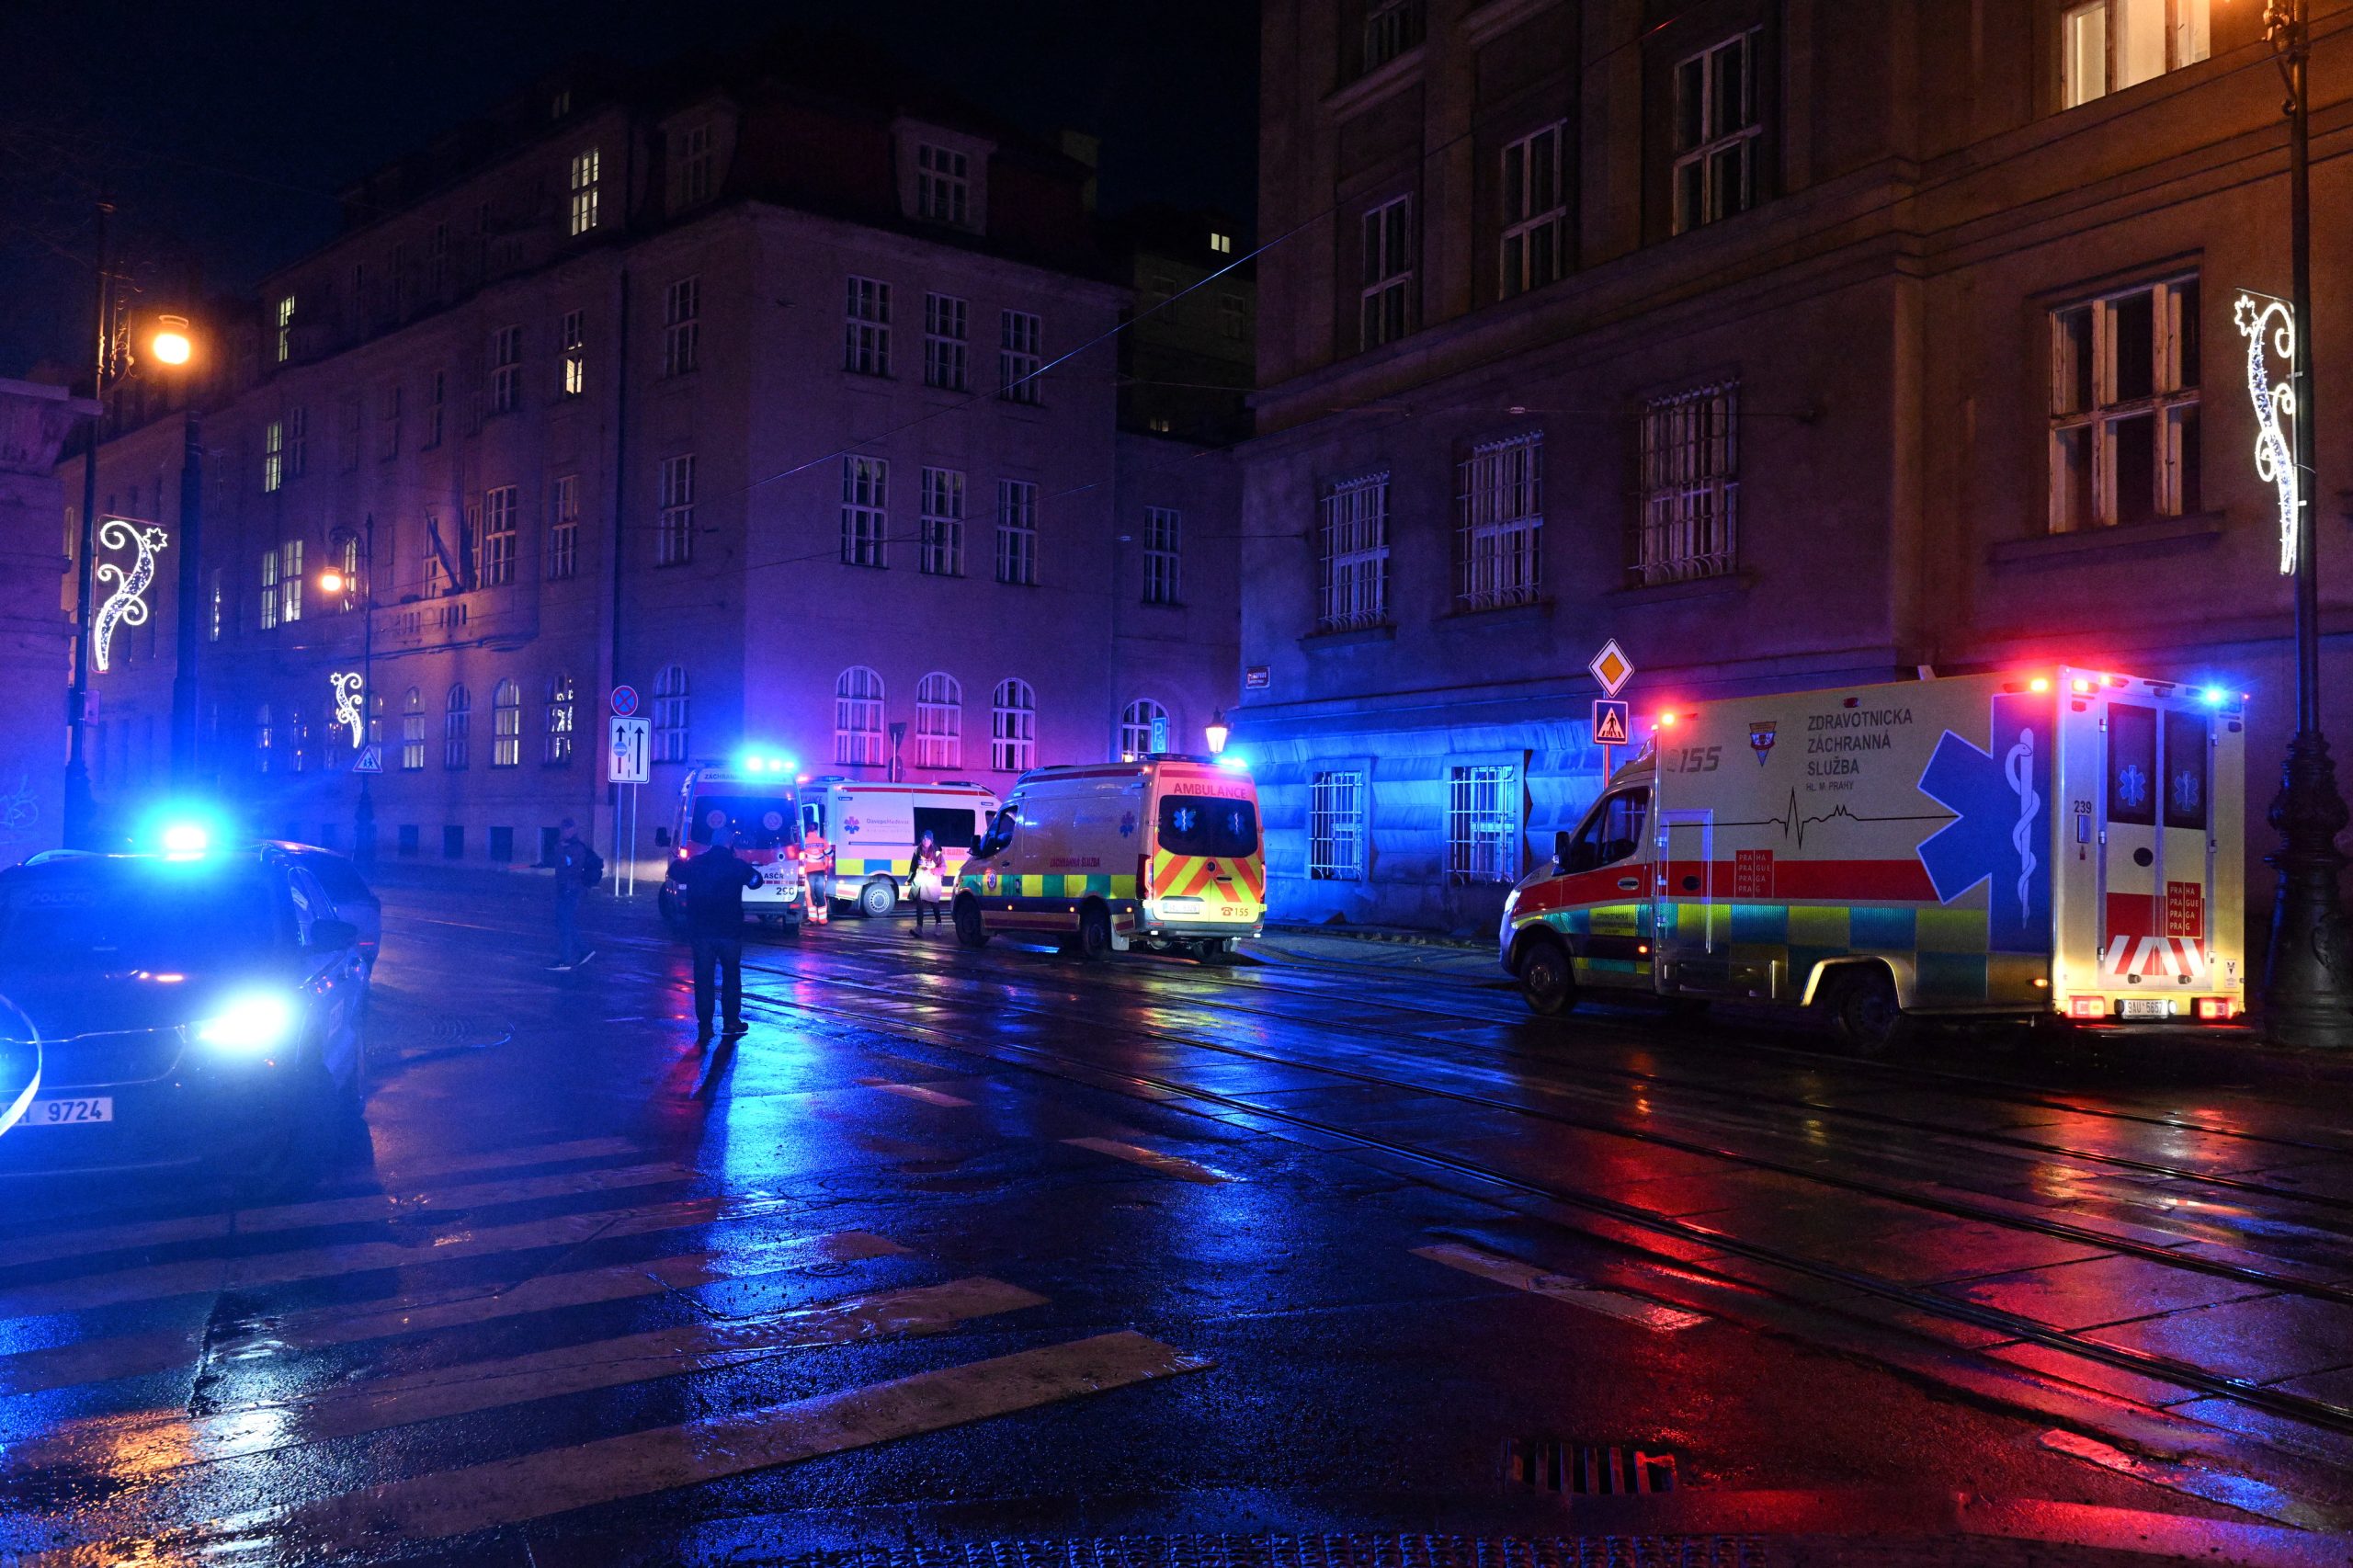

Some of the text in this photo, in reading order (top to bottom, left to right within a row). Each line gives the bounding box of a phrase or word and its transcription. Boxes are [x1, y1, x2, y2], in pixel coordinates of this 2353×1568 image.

[1154, 722, 1164, 743] P
[1807, 731, 1892, 754] ZÁCHRANNÁ
[1679, 745, 1722, 773] 155
[1807, 756, 1860, 776] SLUŽBA
[1173, 782, 1247, 799] AMBULANCE
[1828, 779, 1855, 791] PRAHY
[2074, 800, 2092, 814] 239
[1235, 907, 1249, 916] 155
[48, 1099, 103, 1122] 9724
